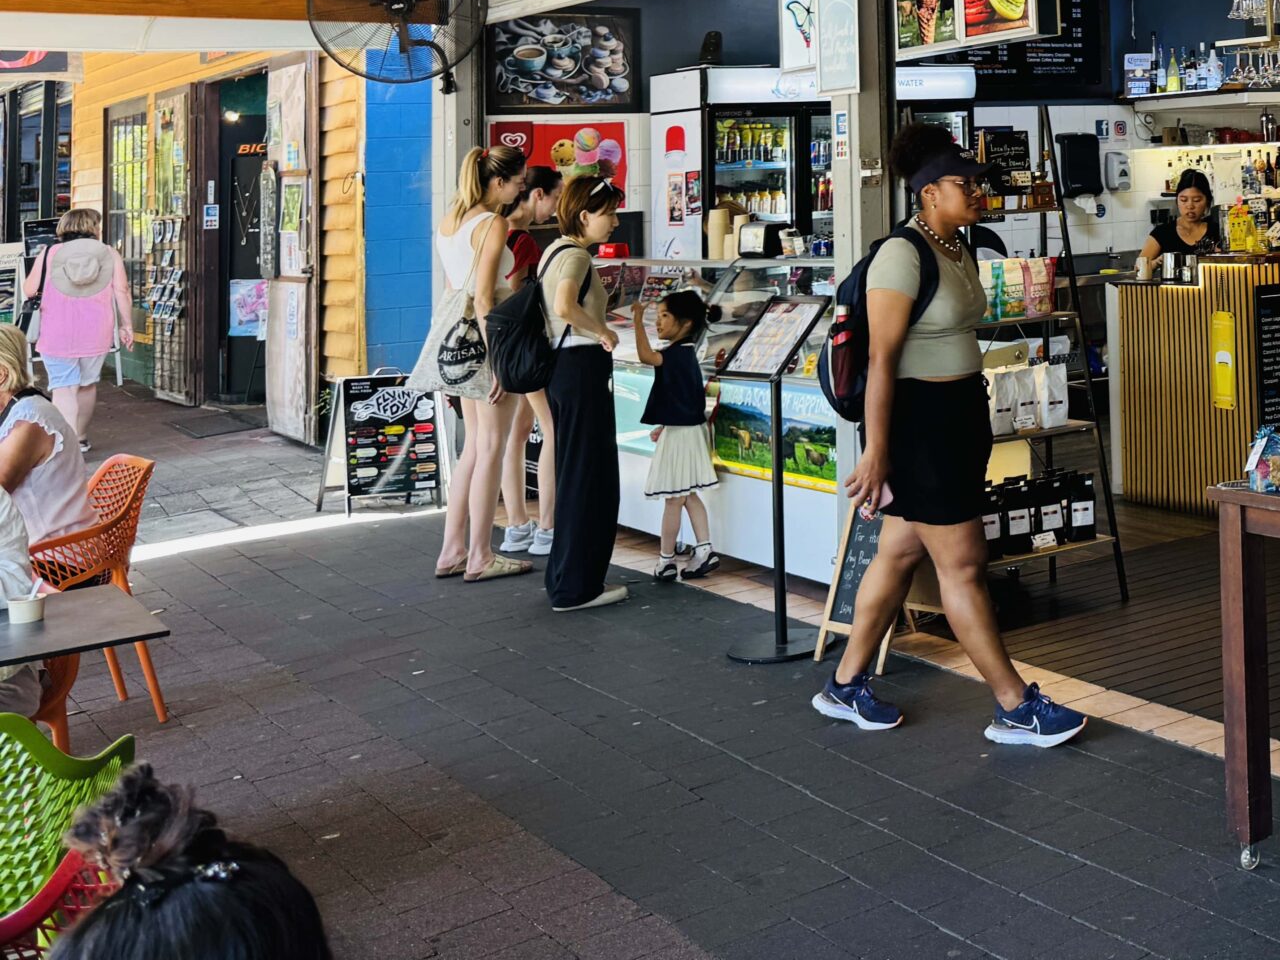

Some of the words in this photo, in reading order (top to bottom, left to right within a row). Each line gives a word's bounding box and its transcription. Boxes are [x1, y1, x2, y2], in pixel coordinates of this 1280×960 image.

[898, 79, 924, 87] WATER
[438, 345, 485, 362] ARTISAN
[382, 399, 408, 416] FOX
